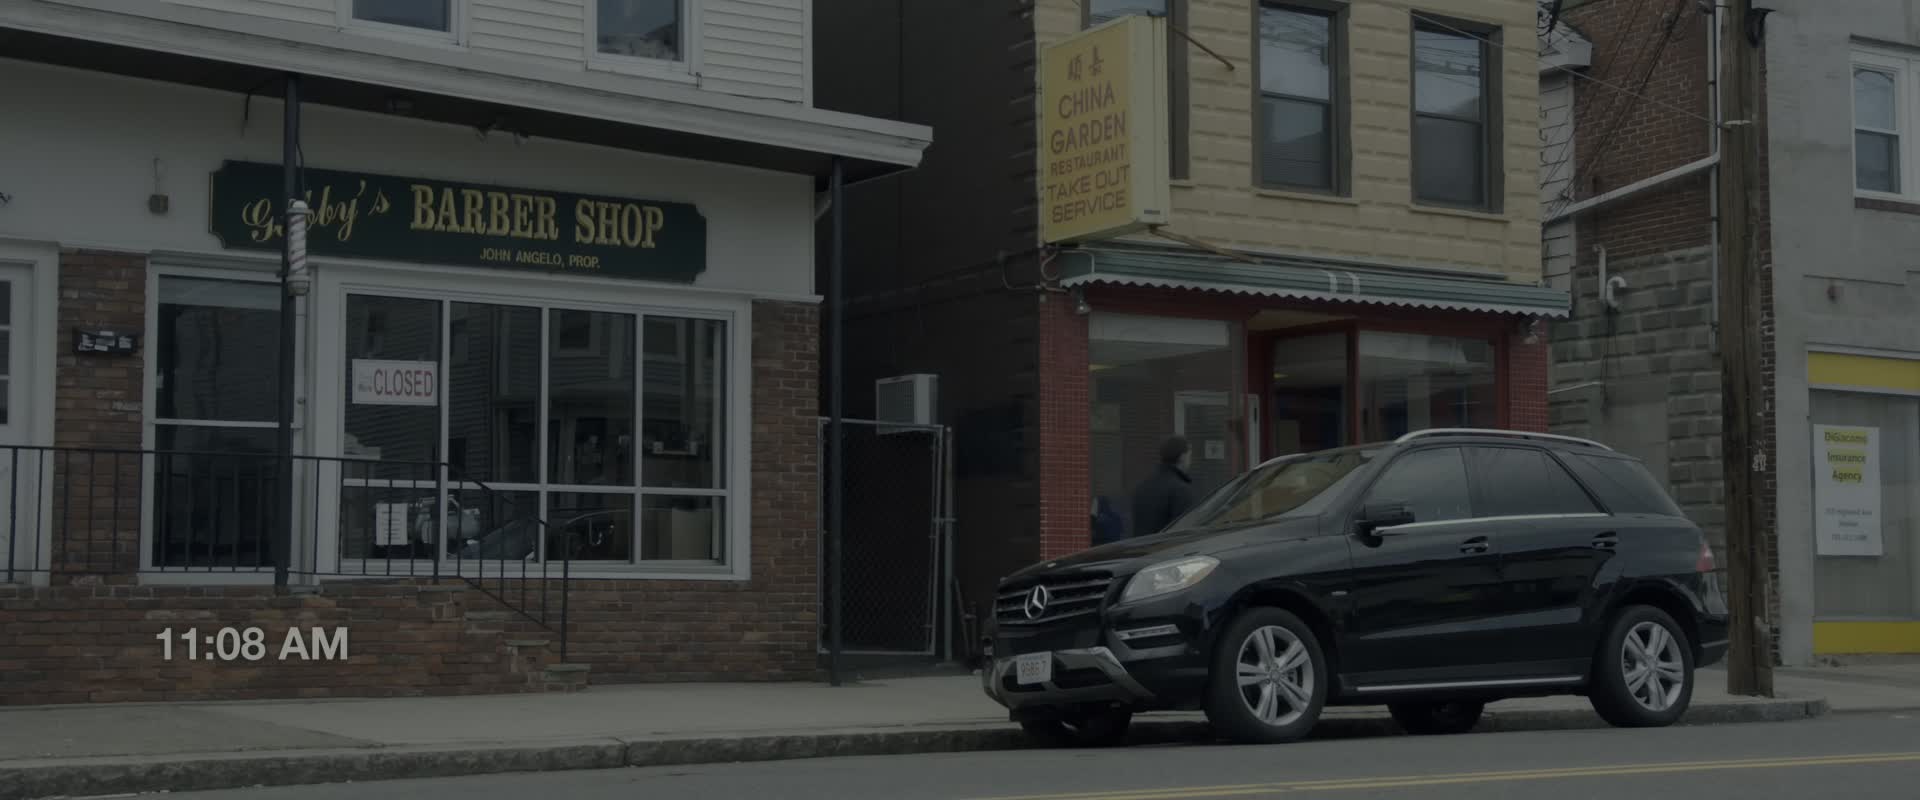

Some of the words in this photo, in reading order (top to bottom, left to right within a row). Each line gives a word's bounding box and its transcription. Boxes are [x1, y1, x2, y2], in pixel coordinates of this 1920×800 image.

[1058, 80, 1116, 120] CHINA
[1050, 111, 1126, 155] GARDEN
[1050, 144, 1126, 177] RESTAURANT
[1047, 175, 1091, 201] TAKE
[1095, 164, 1130, 189] OUT
[409, 184, 559, 241] BARBER
[575, 196, 665, 250] SHOP
[1052, 189, 1127, 224] SERVICE
[480, 247, 512, 262] JOHN
[515, 250, 565, 269] ANGELO,
[568, 254, 601, 269] PROP.
[374, 369, 434, 397] CLOSED
[1827, 452, 1867, 463] Insurance
[1832, 470, 1863, 483] Agency
